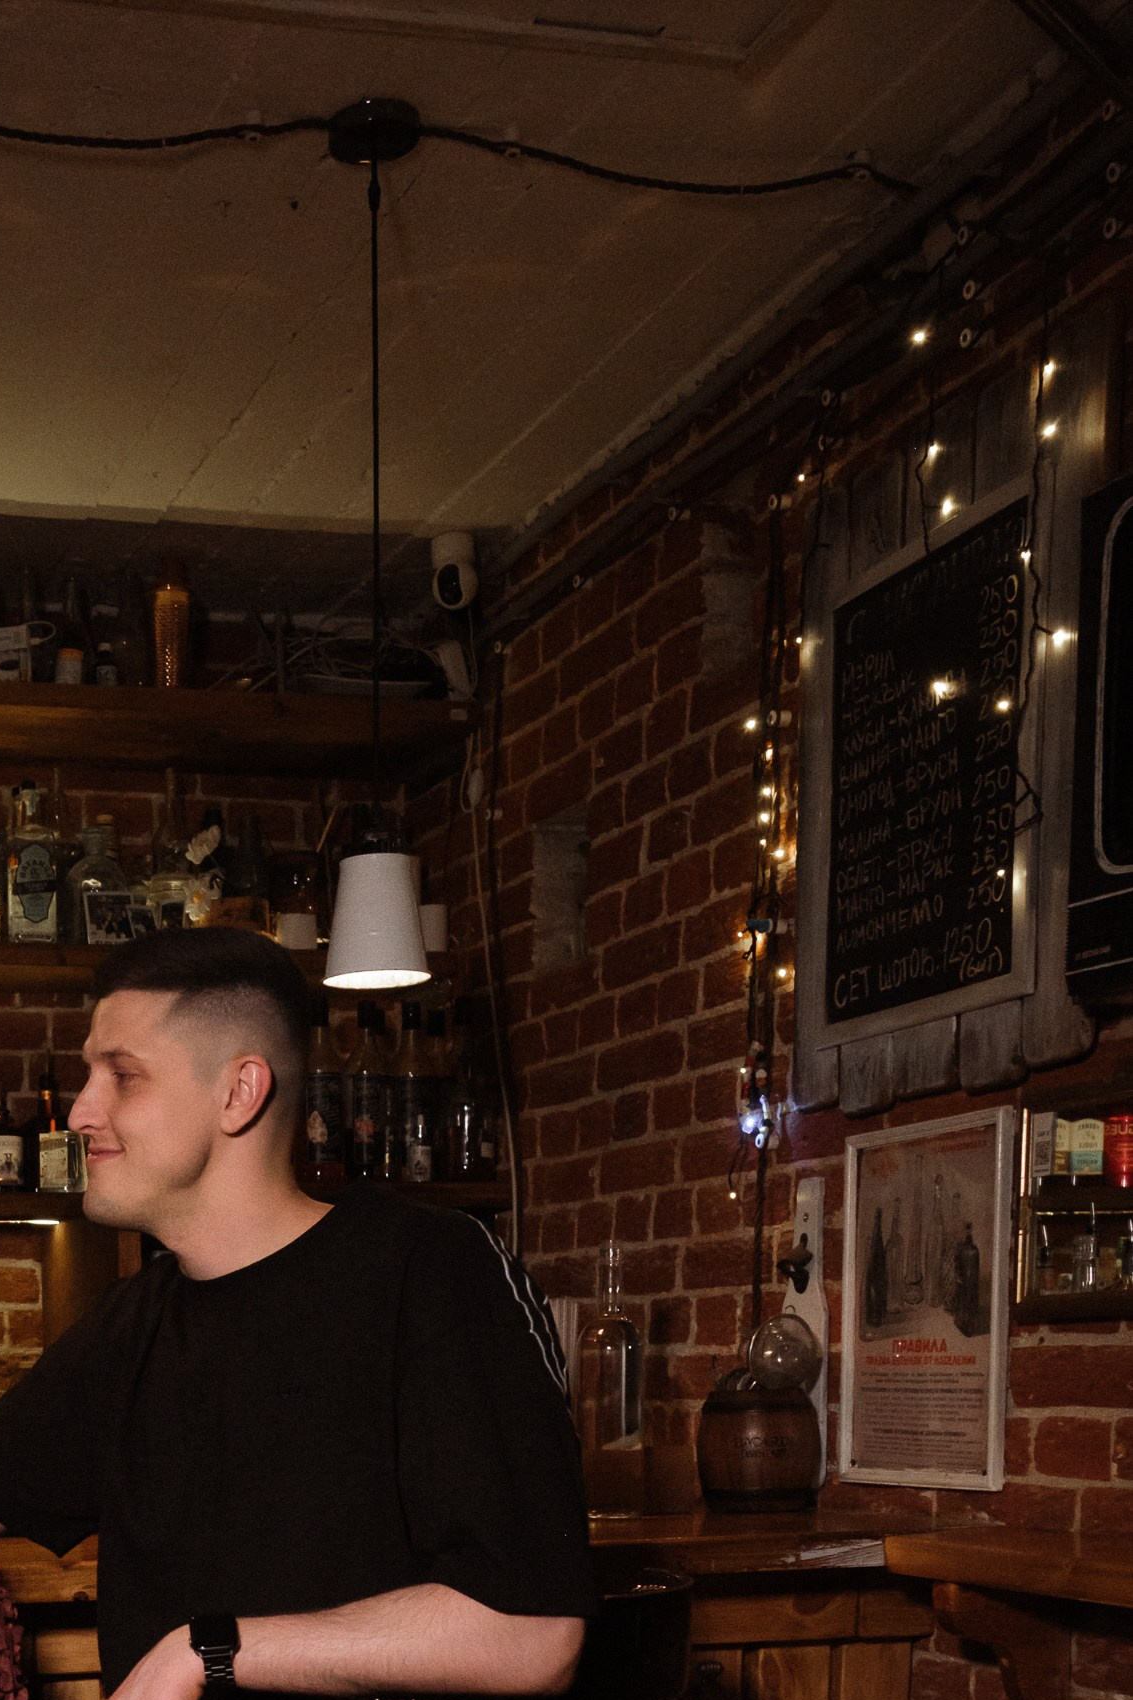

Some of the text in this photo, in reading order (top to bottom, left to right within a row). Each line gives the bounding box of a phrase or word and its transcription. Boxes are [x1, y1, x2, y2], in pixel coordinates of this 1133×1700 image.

[980, 574, 1018, 623] 250
[979, 609, 1017, 648] 250
[979, 640, 1016, 687] 250
[975, 720, 1012, 762] 250
[971, 765, 1010, 807] 250
[973, 803, 1011, 843] 250
[967, 878, 1005, 910] 250
[833, 966, 871, 1008] СЕТ
[943, 918, 991, 972] 1250
[892, 1338, 947, 1353] ПРАВИЛА
